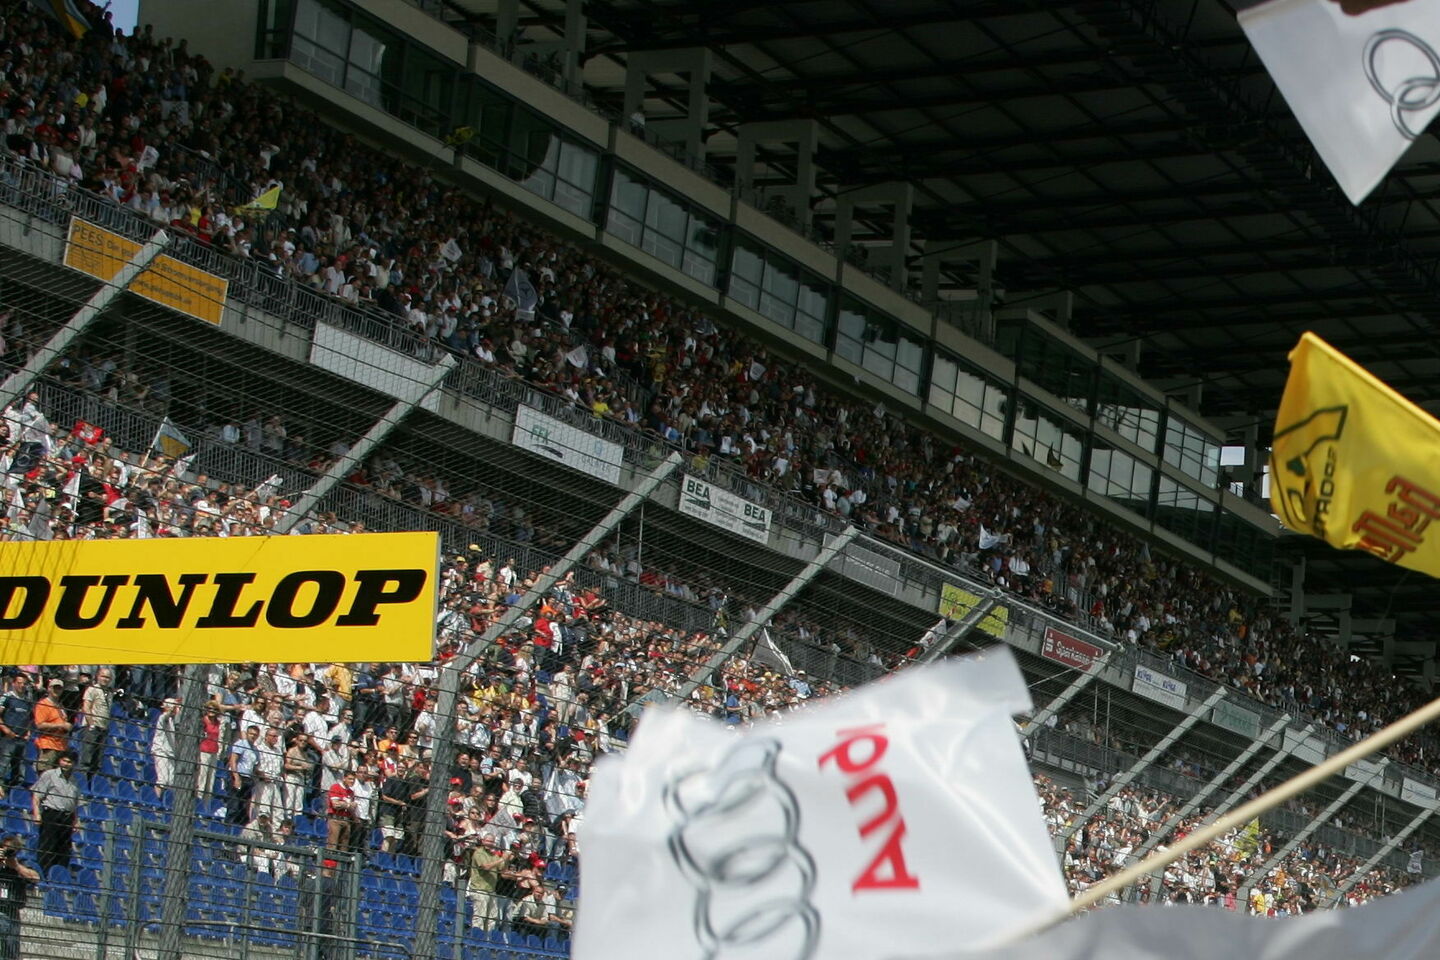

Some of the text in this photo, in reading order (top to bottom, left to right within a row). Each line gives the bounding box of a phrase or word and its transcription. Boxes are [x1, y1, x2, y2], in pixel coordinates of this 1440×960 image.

[73, 223, 105, 246] PEES
[687, 480, 710, 500] BEA
[744, 503, 766, 523] BEA
[0, 569, 428, 631] DUNLOP
[817, 722, 920, 897] Audi
